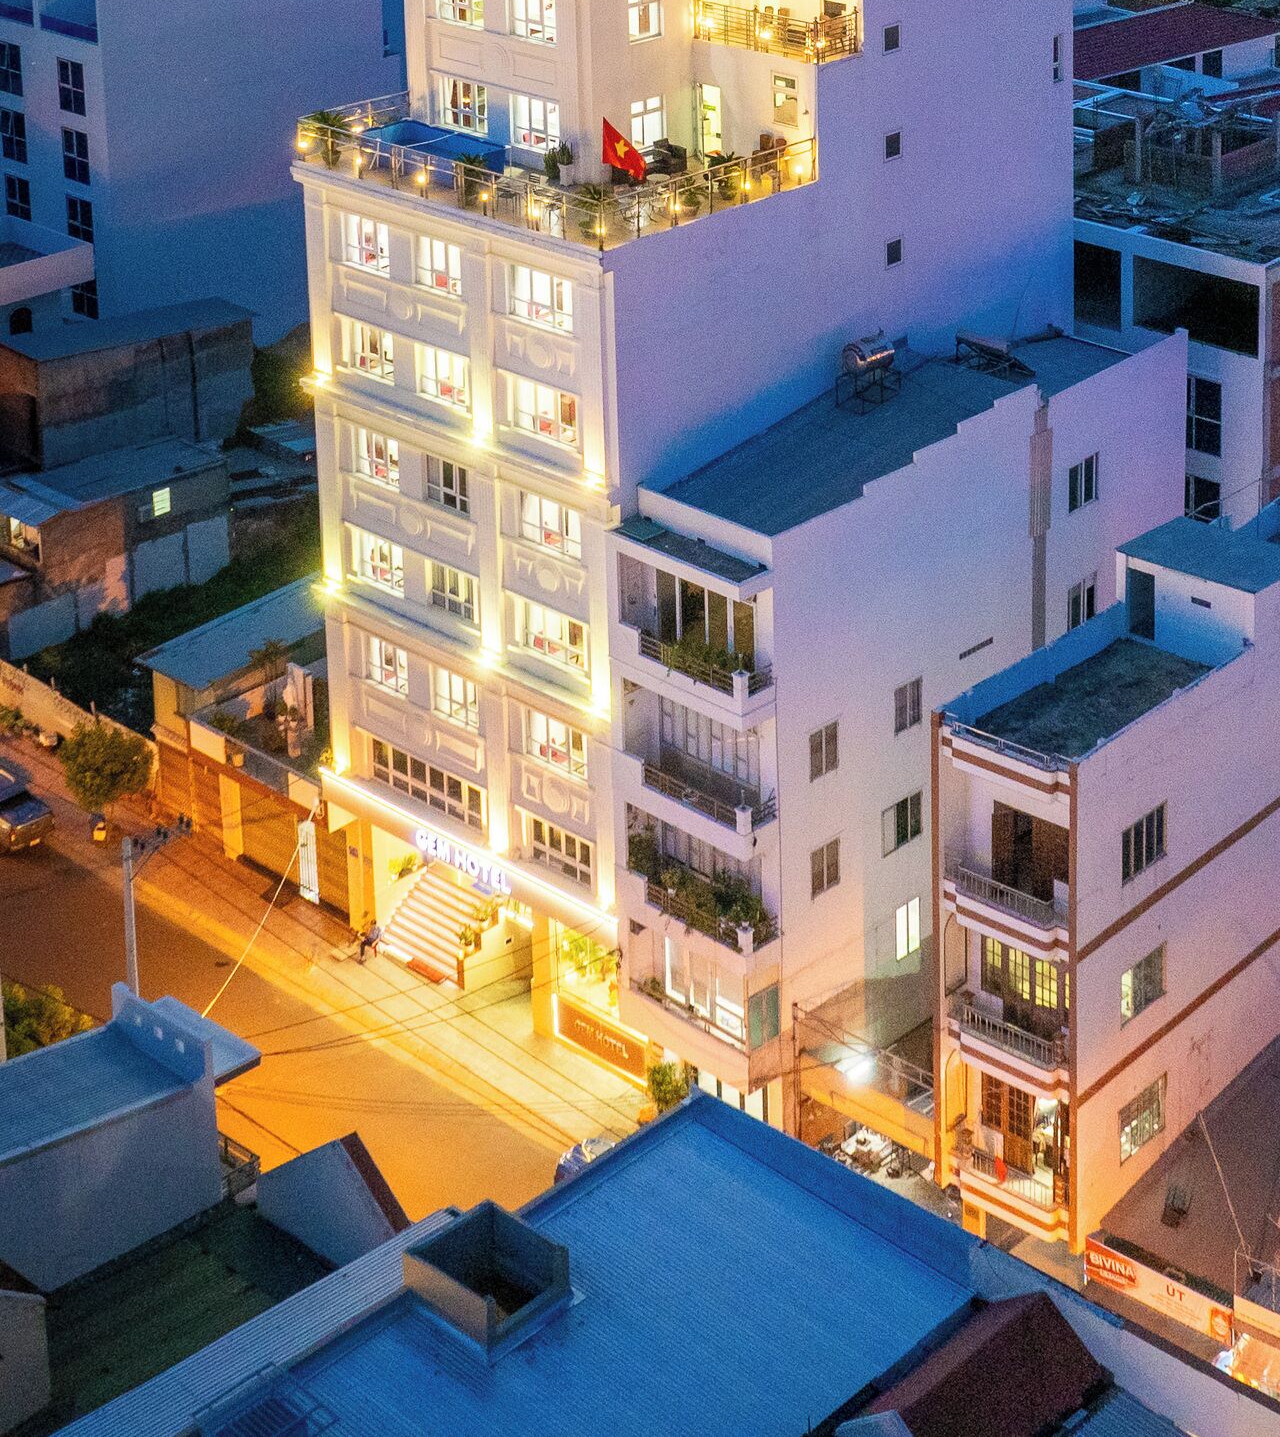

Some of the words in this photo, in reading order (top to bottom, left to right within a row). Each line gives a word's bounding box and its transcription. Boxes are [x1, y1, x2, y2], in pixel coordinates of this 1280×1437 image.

[415, 828, 451, 864] GEM
[454, 848, 513, 895] HOTEL
[1089, 1250, 1136, 1279] BIVINA
